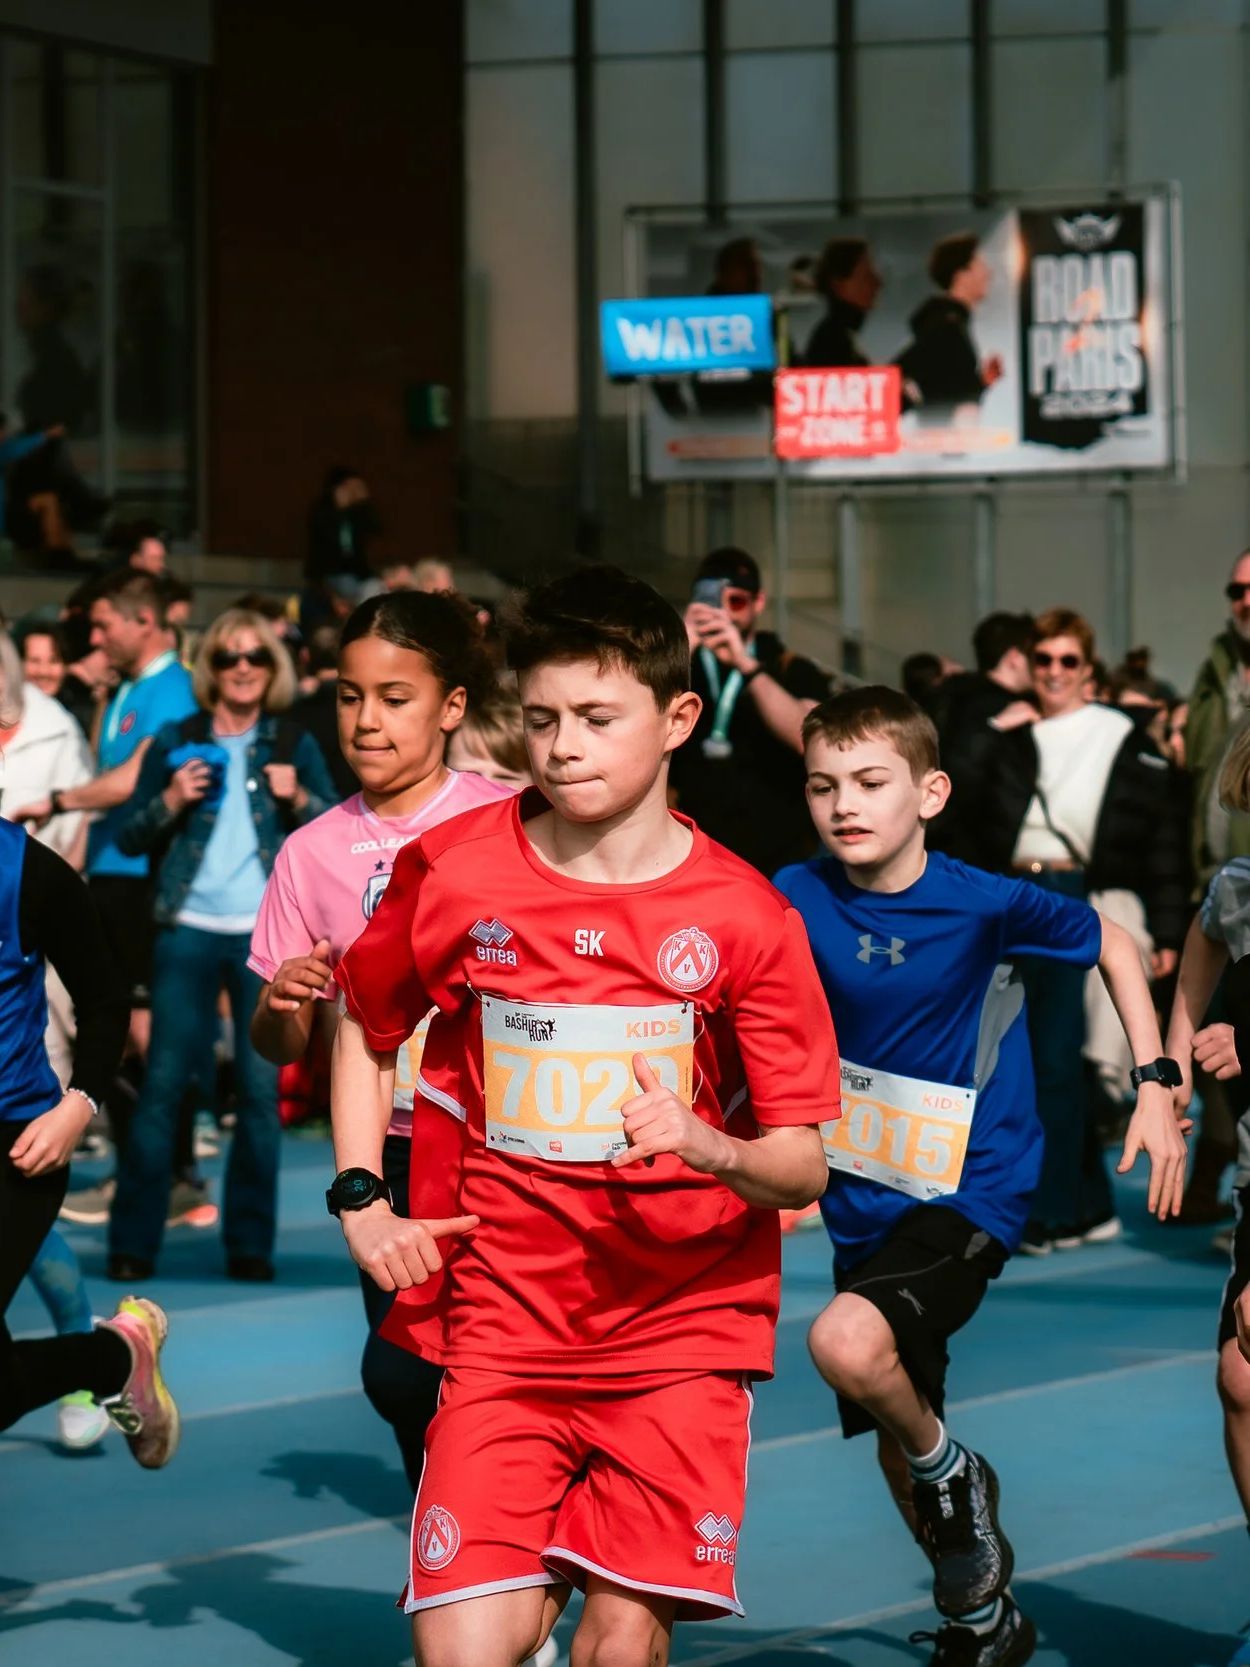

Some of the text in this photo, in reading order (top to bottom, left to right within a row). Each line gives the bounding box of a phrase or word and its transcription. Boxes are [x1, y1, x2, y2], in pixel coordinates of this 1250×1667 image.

[1033, 251, 1137, 323] ROAD
[616, 315, 755, 361] WATER
[1028, 322, 1143, 395] PARIS
[780, 374, 887, 414] START
[800, 415, 866, 446] ZONE
[476, 945, 517, 967] errea
[575, 929, 606, 957] SK
[626, 1018, 681, 1038] KIDS
[922, 1092, 964, 1112] KIDS
